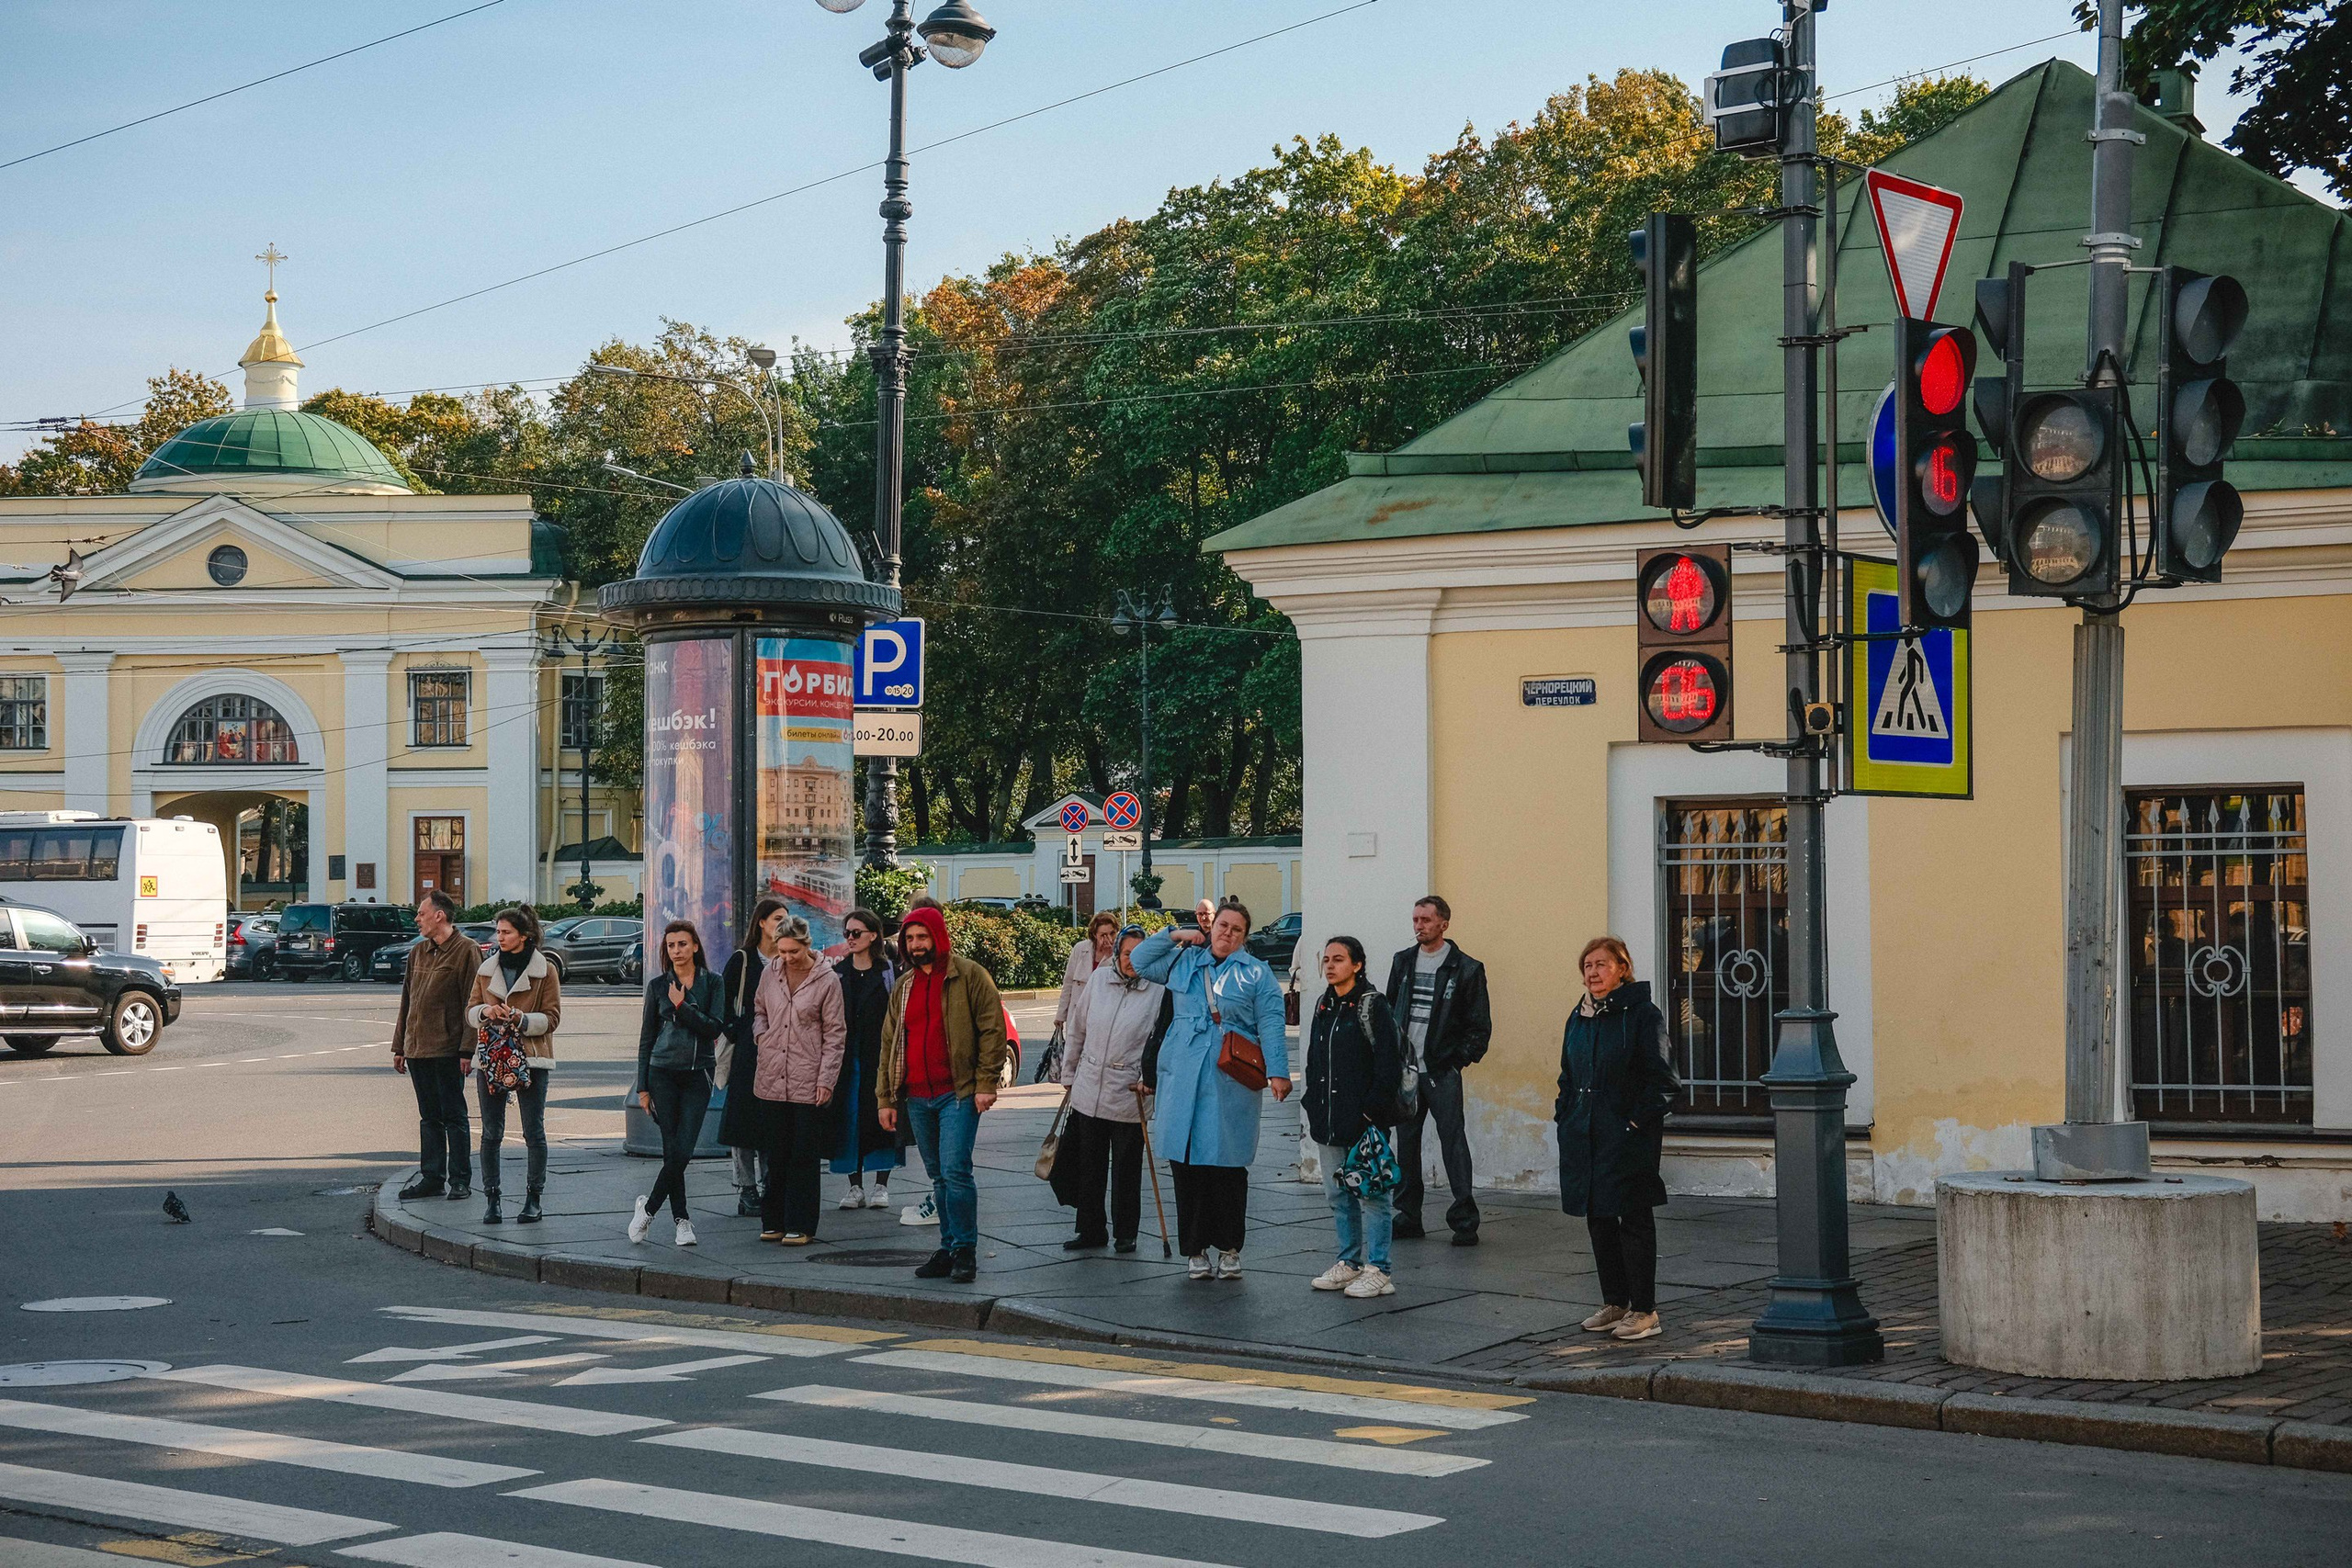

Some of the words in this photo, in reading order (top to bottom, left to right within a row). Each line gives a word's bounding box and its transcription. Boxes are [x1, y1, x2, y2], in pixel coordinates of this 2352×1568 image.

[838, 613, 854, 625] Russ
[902, 685, 913, 696] 20
[1524, 681, 1593, 694] ЧЕРНОРЕЦКИЙ
[1661, 665, 1716, 721] 06
[1535, 695, 1581, 706] ПЕРЕУЛОК
[786, 728, 817, 739] билеты
[670, 738, 717, 751] кешбэка
